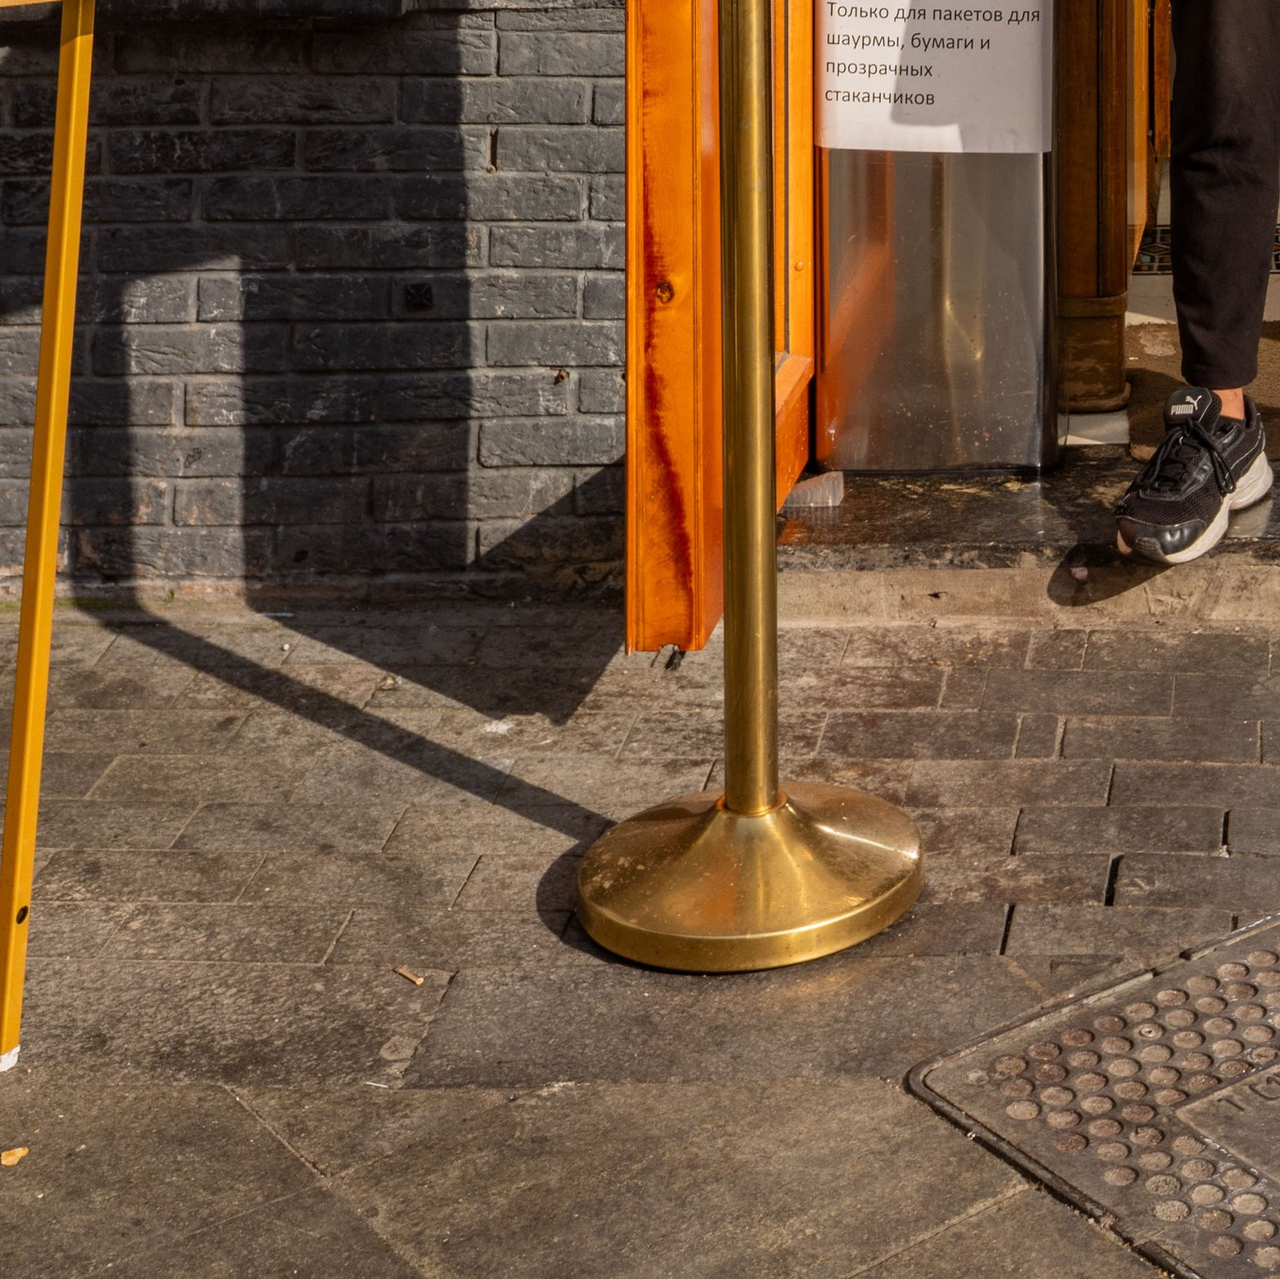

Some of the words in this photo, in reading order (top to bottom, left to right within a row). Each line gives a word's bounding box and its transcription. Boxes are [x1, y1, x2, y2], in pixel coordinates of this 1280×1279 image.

[826, 1, 889, 19] Только
[894, 6, 926, 23] для
[932, 7, 1003, 23] пакетов
[1007, 7, 1041, 25] для
[826, 32, 905, 52] шаурмы,
[911, 33, 975, 52] бумаги
[980, 37, 991, 50] и
[825, 61, 933, 78] прозрачных
[824, 89, 936, 106] стаканчиков
[1170, 404, 1194, 416] PUMA
